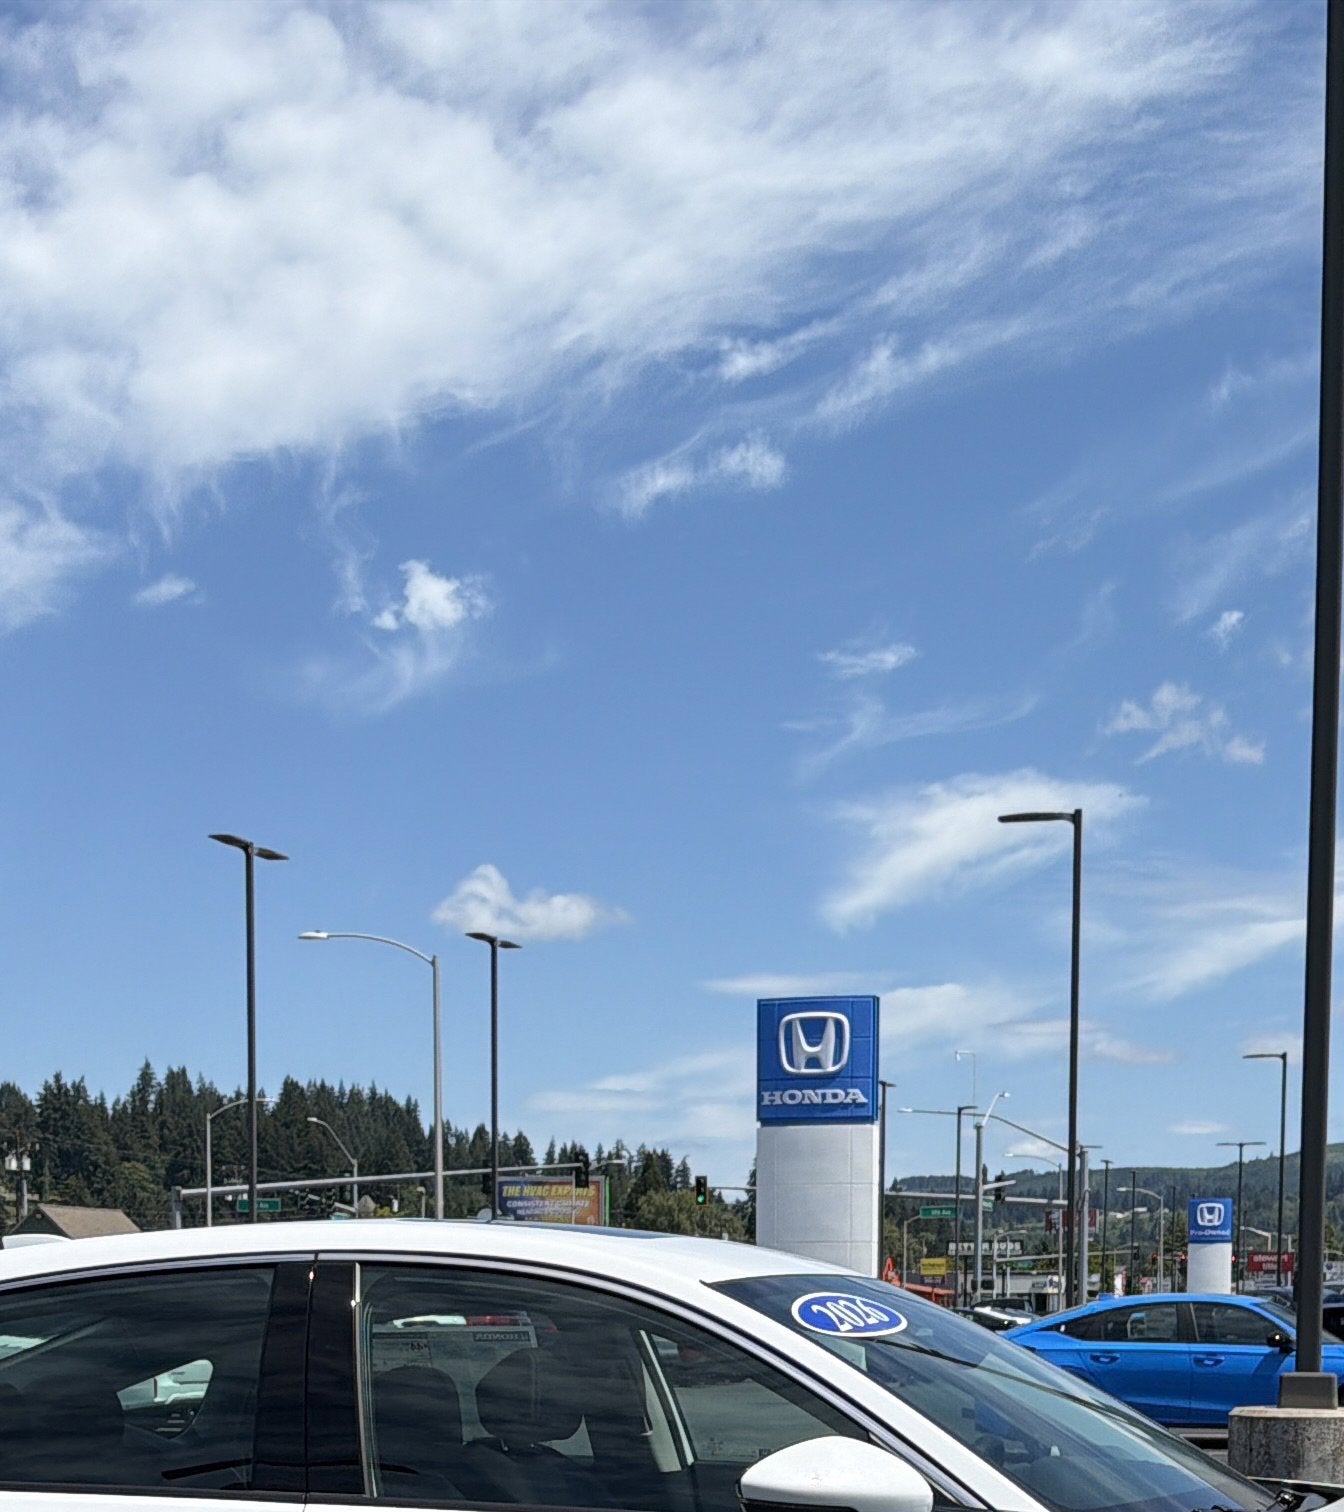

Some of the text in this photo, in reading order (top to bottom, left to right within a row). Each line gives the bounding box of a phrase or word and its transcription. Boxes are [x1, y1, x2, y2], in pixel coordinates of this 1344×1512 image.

[761, 1089, 868, 1105] HONDA
[502, 1185, 596, 1197] THE HVAC EXPRTS
[811, 1299, 890, 1331] 2026
